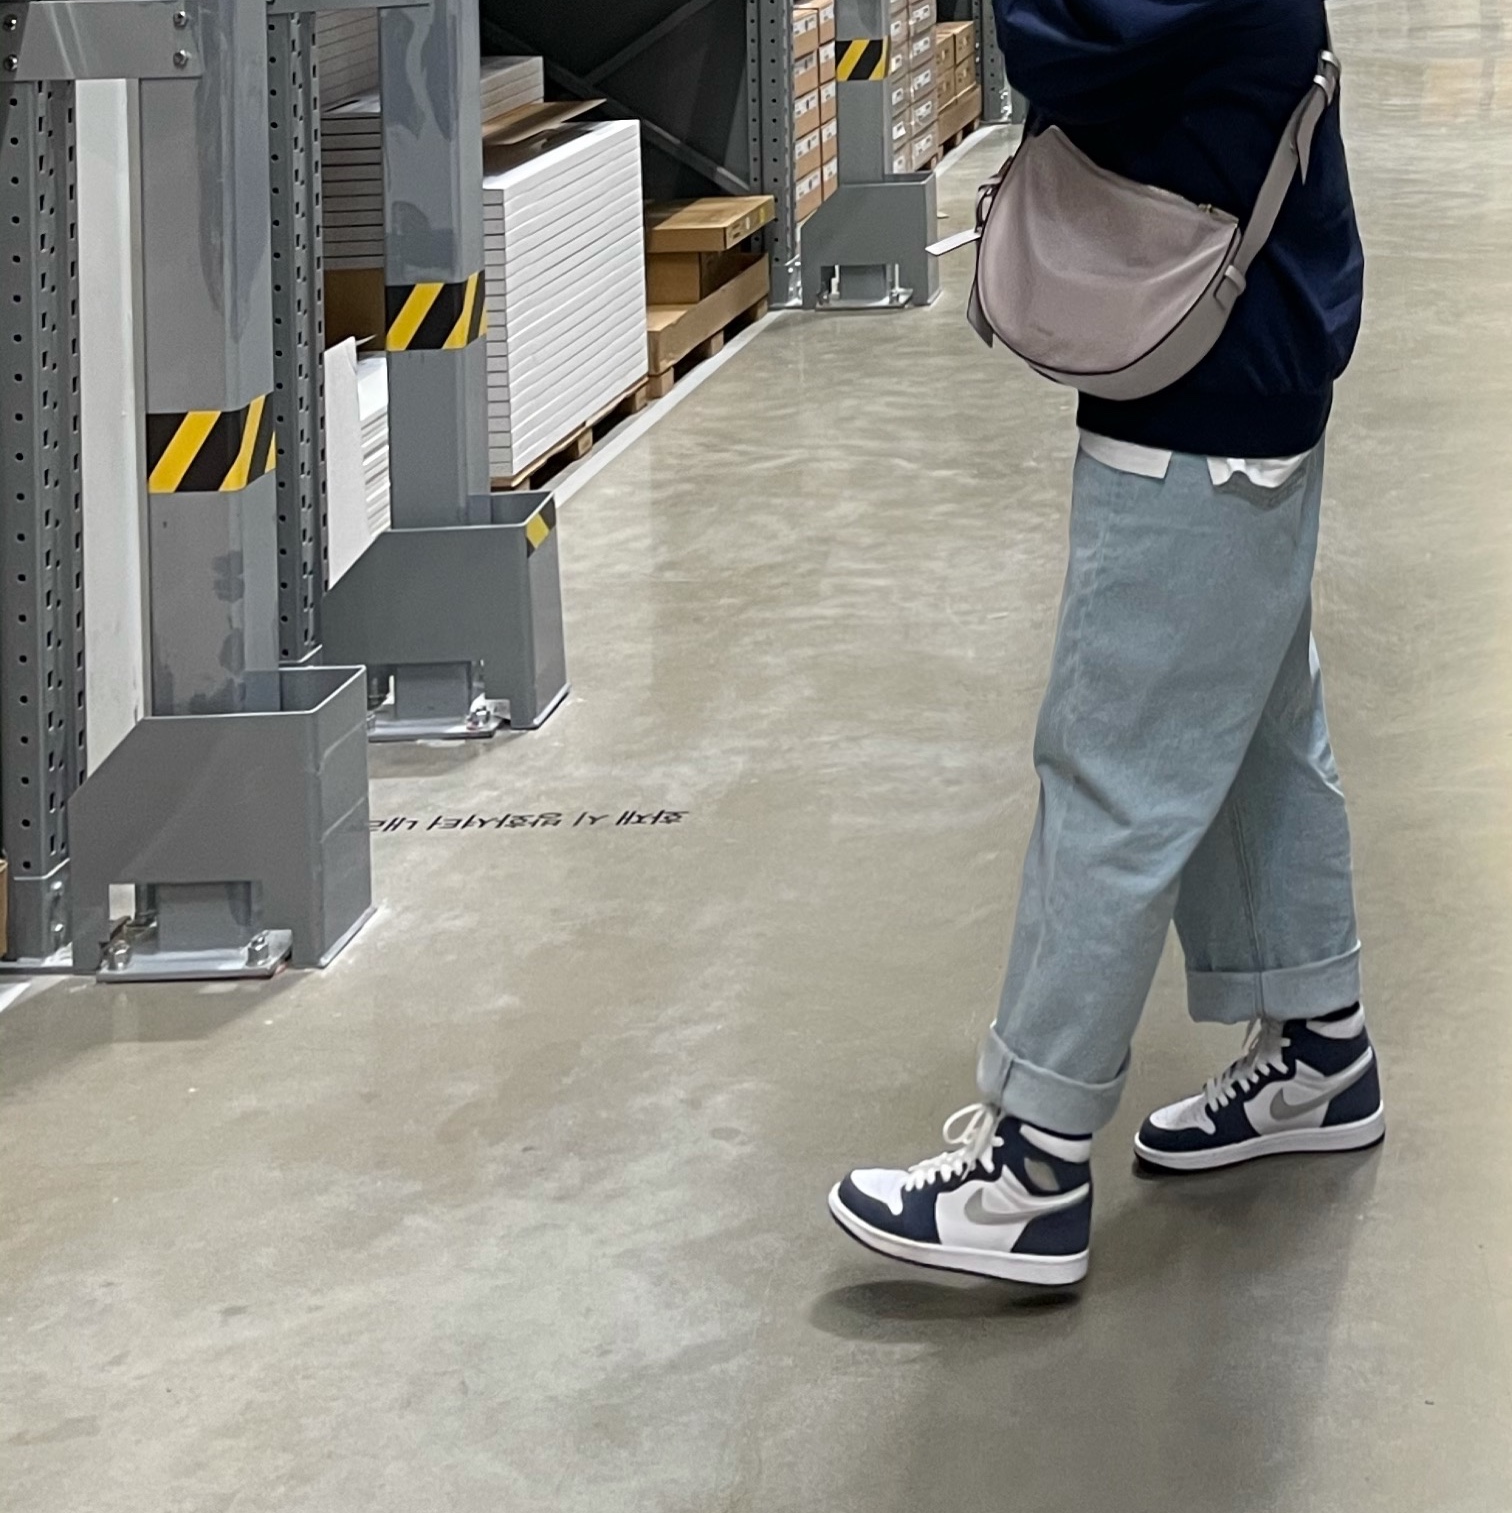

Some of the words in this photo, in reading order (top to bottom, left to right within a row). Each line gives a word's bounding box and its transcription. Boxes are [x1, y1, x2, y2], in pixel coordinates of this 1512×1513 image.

[426, 812, 563, 832] 방화셔터
[572, 811, 610, 828] 시
[615, 809, 690, 827] 화재
